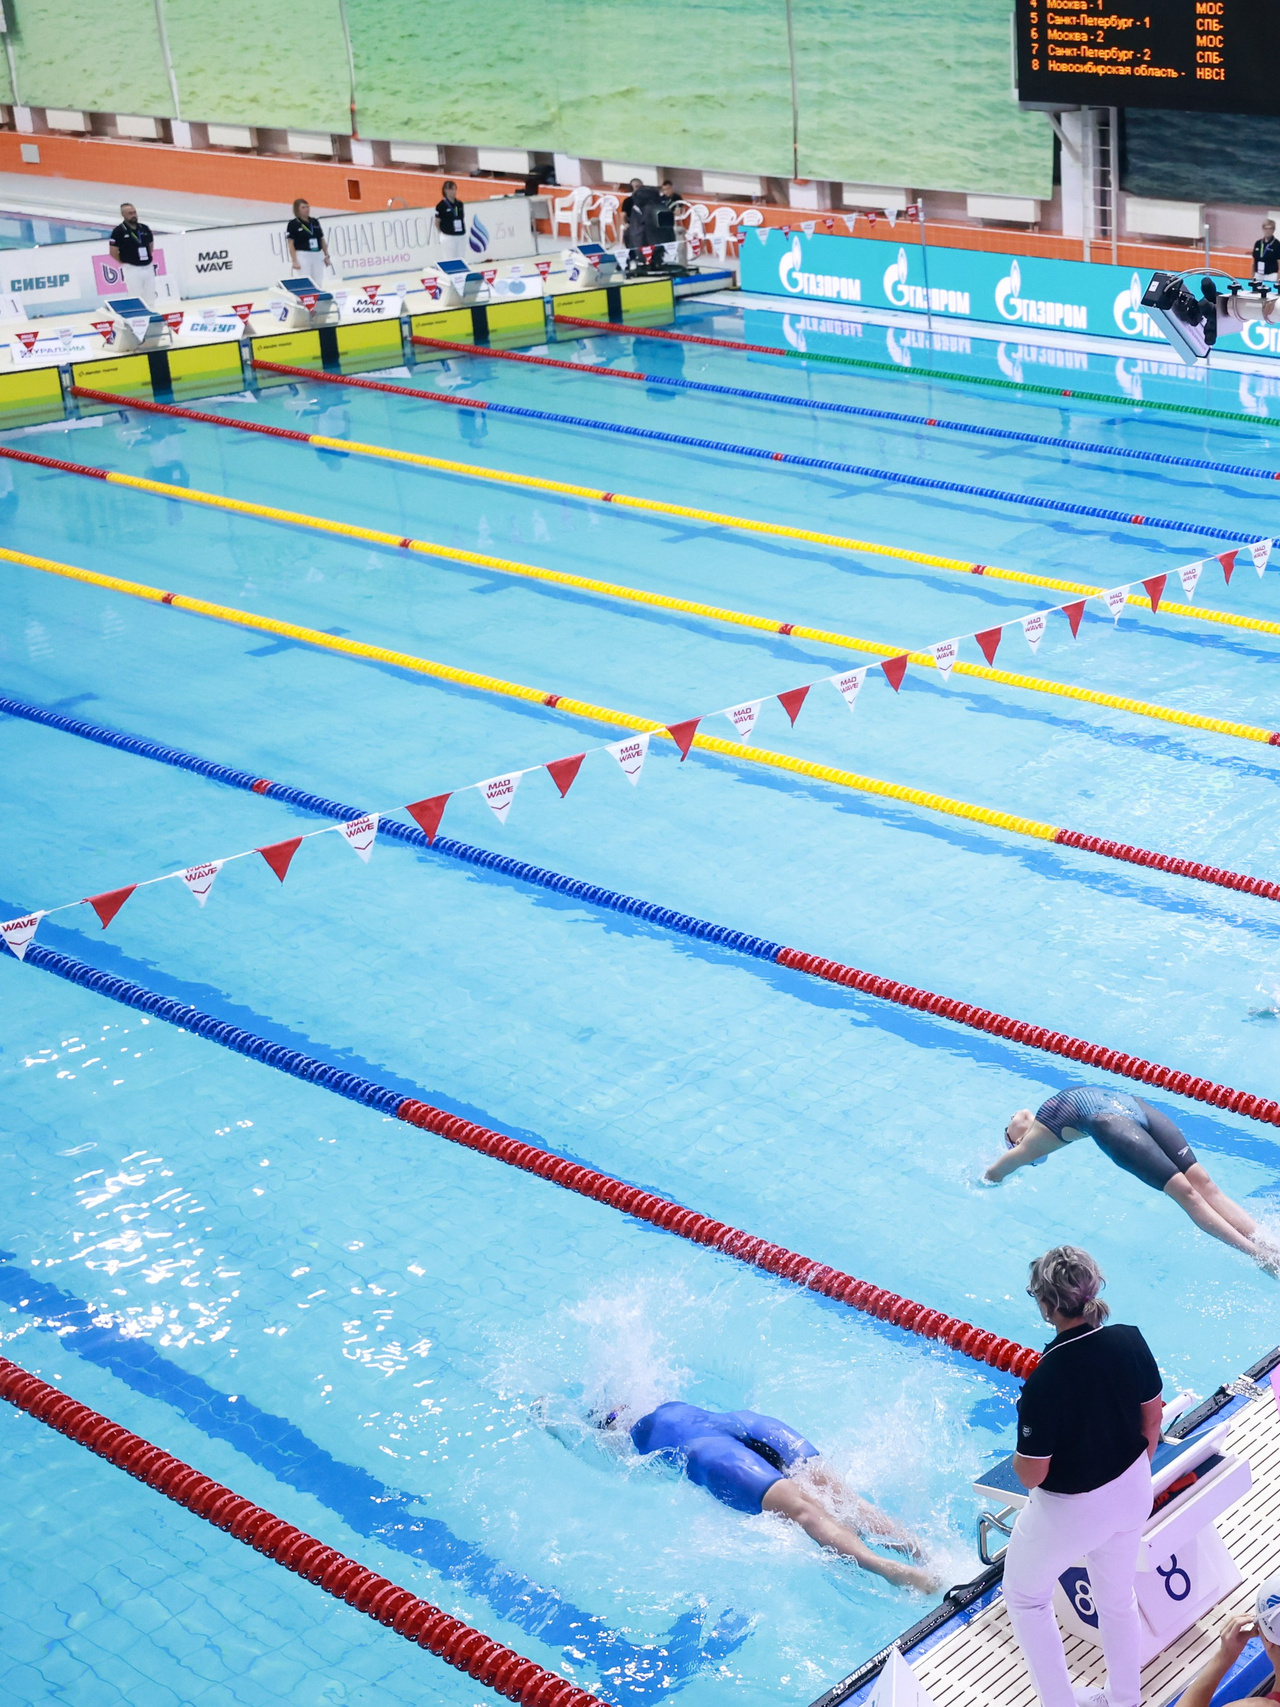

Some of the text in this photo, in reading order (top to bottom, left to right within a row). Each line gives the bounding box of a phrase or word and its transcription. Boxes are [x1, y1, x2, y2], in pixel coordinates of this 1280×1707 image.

[1196, 2, 1224, 15] МОС
[1030, 12, 1038, 24] 5
[1047, 12, 1134, 30] Санкт-Петербург
[1143, 16, 1150, 28] 1
[1030, 27, 1039, 40] 6
[1047, 28, 1088, 42] Москва
[1096, 30, 1104, 43] 2
[1196, 34, 1224, 48] МОС
[1031, 43, 1039, 55] 7
[1047, 44, 1134, 62] Санкт-Петербург
[1143, 48, 1151, 60] 2
[1031, 58, 1040, 71] 8
[1048, 59, 1132, 77] Новосибирская
[1133, 64, 1179, 78] область
[198, 250, 228, 262] MAD
[342, 252, 411, 269] плаванию
[196, 261, 233, 273] WAVE
[11, 273, 70, 292] СИБУР
[802, 272, 861, 301] ГАЗПРОМ
[1023, 296, 1087, 329] ГАЗПРОМ
[1025, 622, 1044, 633] WAVE
[1027, 616, 1041, 626] MAD
[936, 649, 955, 661] WAVE
[937, 643, 952, 654] MAD
[840, 676, 857, 687] MAD
[840, 682, 859, 694] WAVE
[733, 706, 752, 718] MAD
[733, 713, 754, 725] WAVE
[619, 749, 643, 763] WAVE
[620, 743, 640, 755] MAD
[488, 778, 511, 791] MAD
[486, 785, 514, 800] WAVE
[346, 822, 374, 838] WAVE
[347, 817, 370, 830] MAD
[185, 867, 218, 882] WAVE
[1, 917, 38, 933] WAVE
[1075, 1580, 1096, 1616] 8
